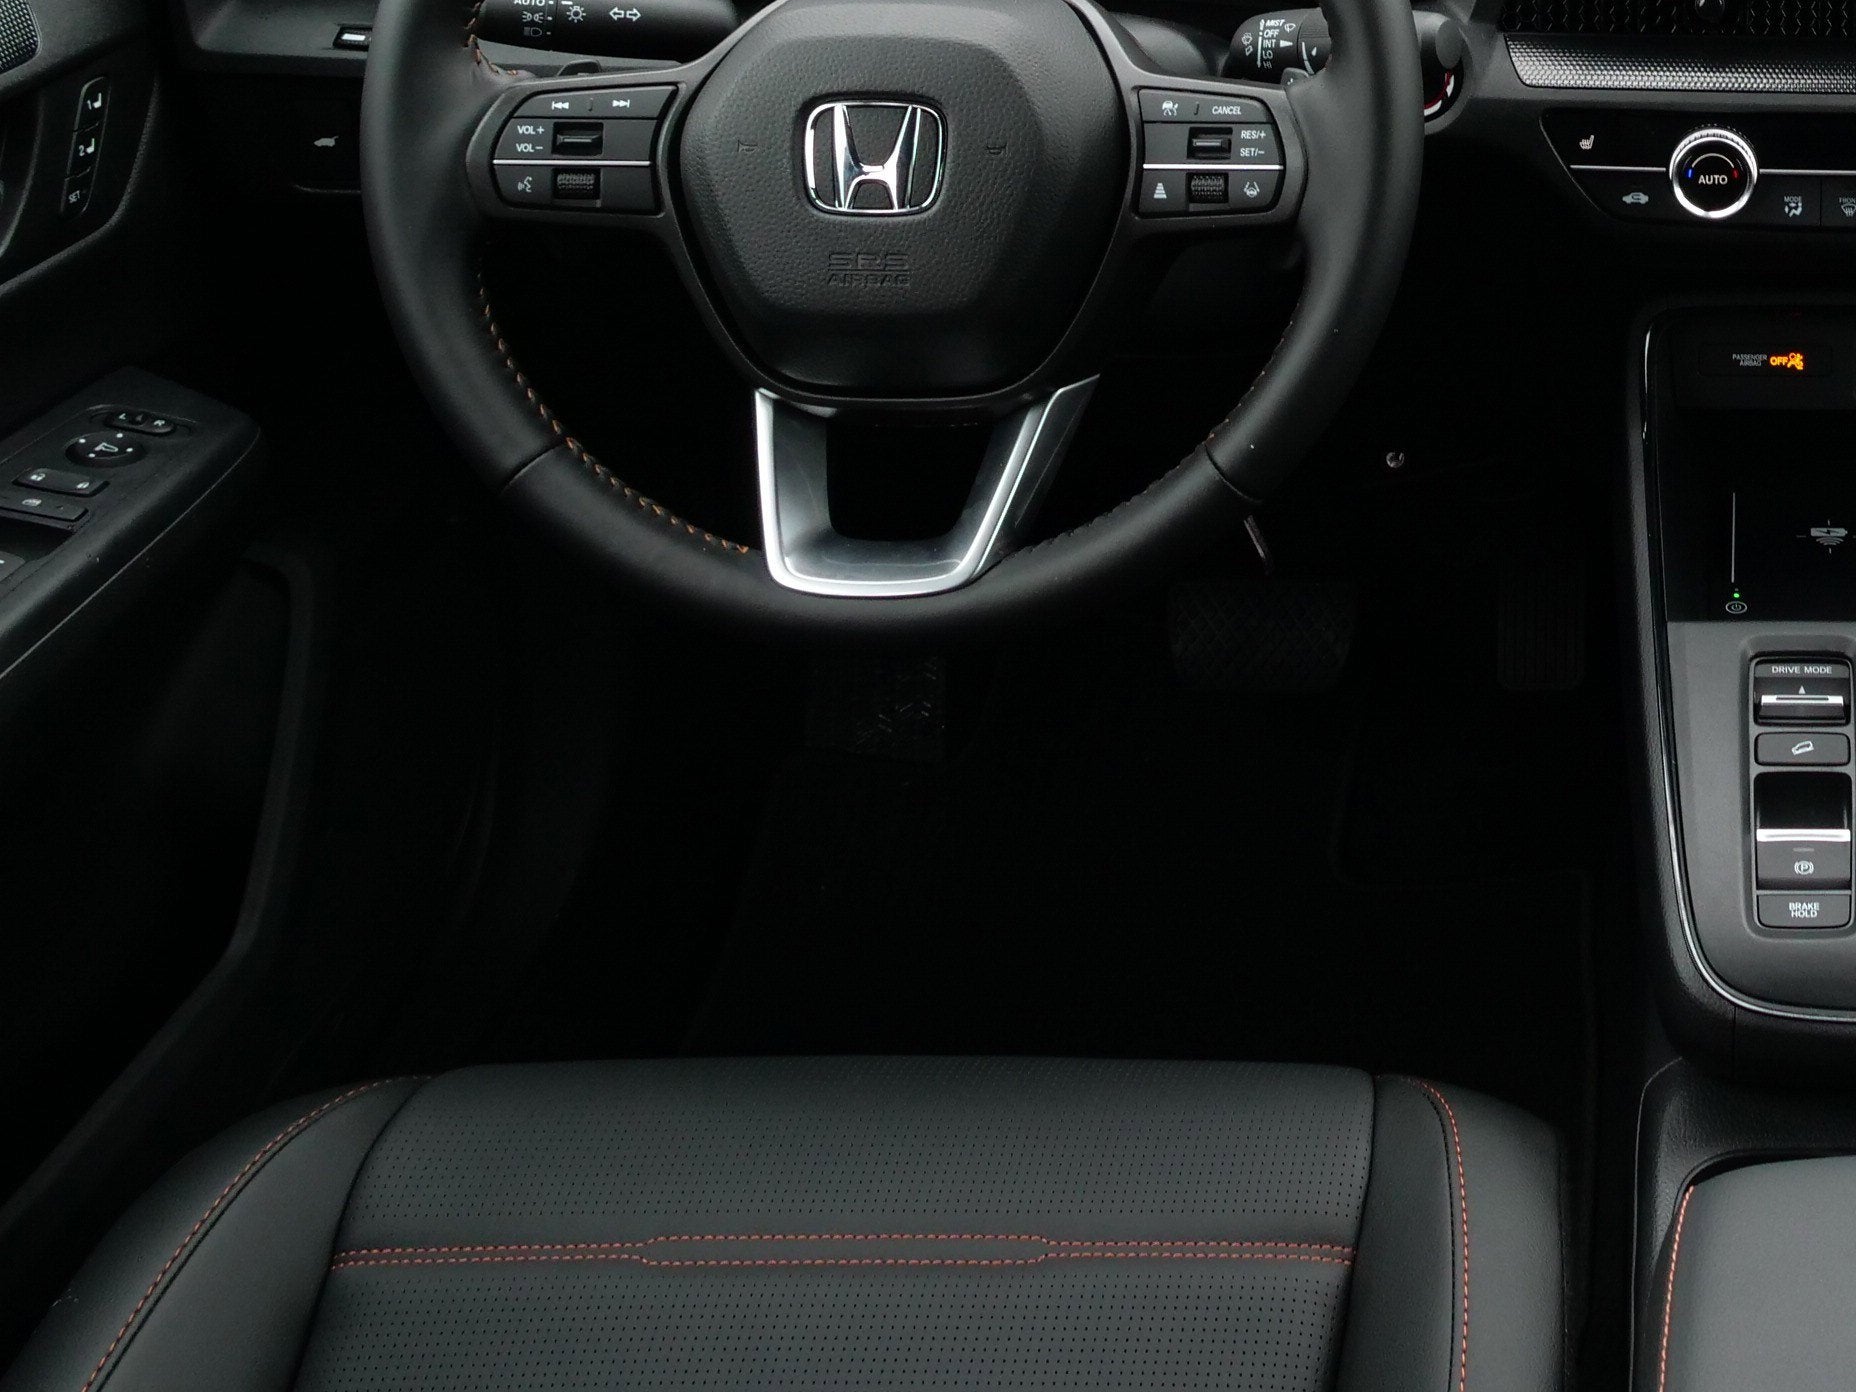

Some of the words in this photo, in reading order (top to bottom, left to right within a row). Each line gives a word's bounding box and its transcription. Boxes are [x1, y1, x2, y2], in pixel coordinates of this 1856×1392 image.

[1264, 29, 1280, 38] OFF
[1263, 39, 1276, 48] INT
[1262, 50, 1274, 60] LO
[1212, 106, 1242, 115] CANCEL
[1240, 130, 1266, 140] RES/+
[1698, 174, 1728, 186] AUTO
[1770, 356, 1788, 366] OFF
[1772, 666, 1800, 674] DRIVE
[1804, 666, 1833, 674] MODE
[1788, 902, 1820, 911] BRAKE
[1790, 910, 1818, 918] HOLD
